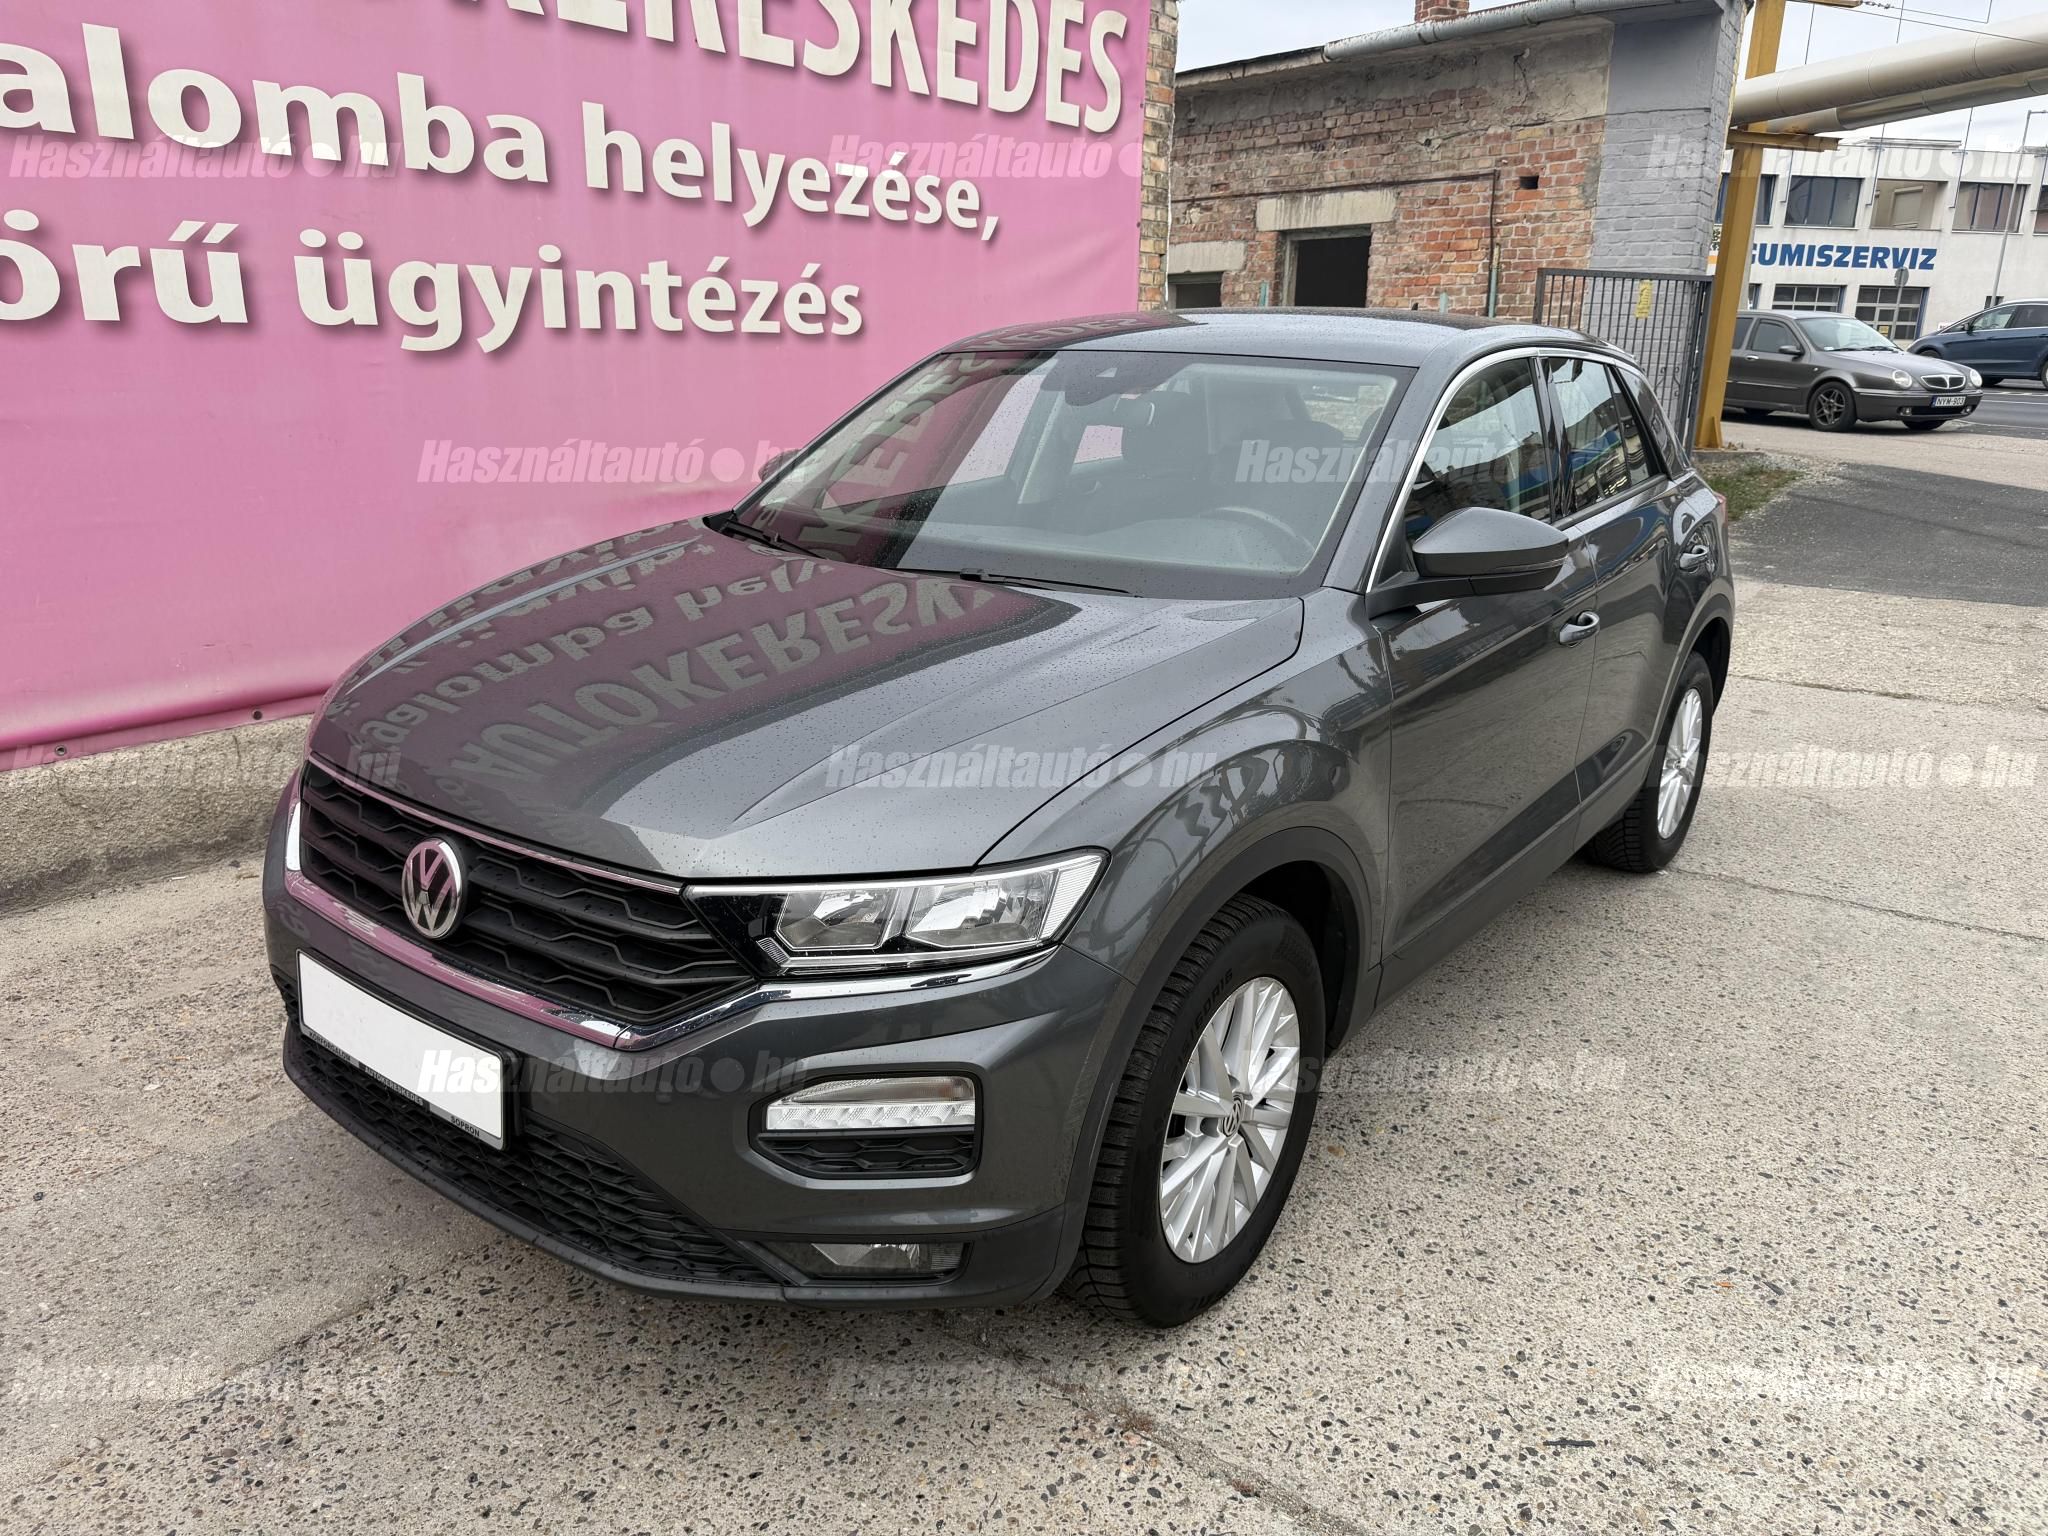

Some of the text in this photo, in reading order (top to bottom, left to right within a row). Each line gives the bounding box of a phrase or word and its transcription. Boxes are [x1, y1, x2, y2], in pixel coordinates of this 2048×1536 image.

[582, 100, 999, 241] helyezése,
[294, 228, 862, 353] ügyintézés
[451, 1115, 480, 1137] SOPRON
